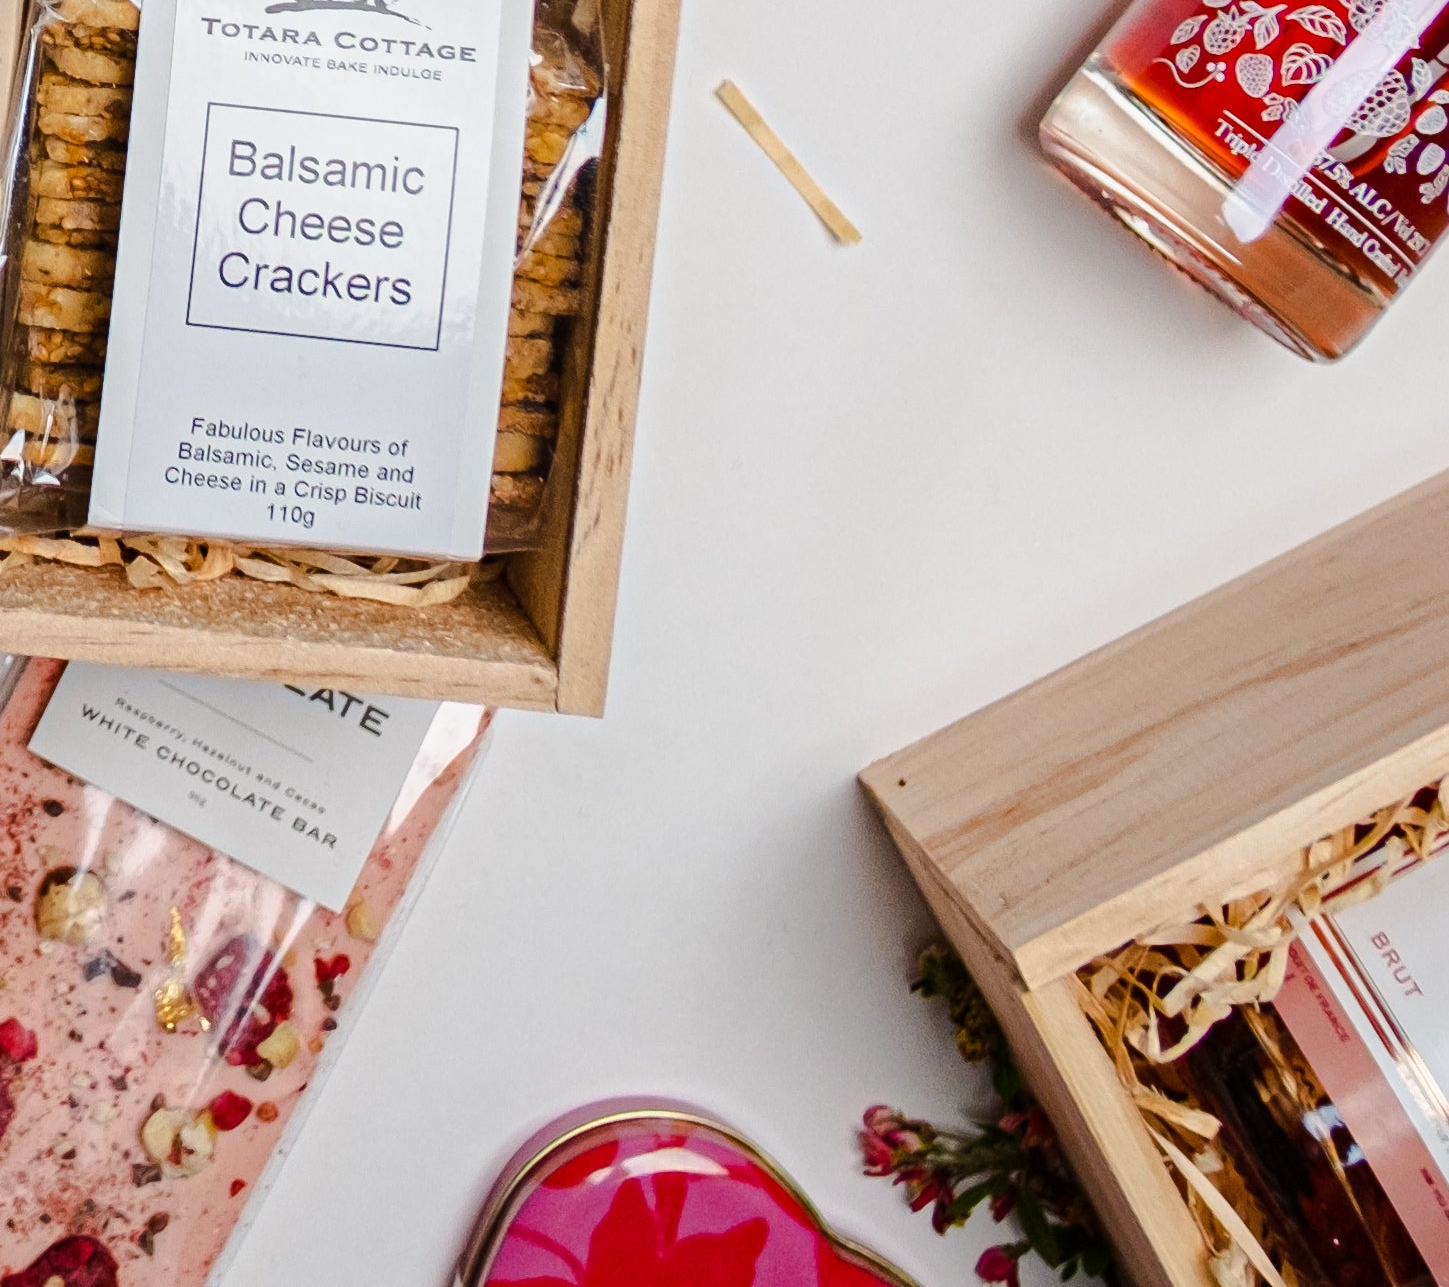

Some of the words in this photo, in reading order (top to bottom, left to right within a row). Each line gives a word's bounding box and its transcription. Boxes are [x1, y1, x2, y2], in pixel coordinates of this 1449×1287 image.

[201, 17, 322, 47] TOTARA
[334, 31, 477, 63] COTTAGE
[244, 50, 321, 69] INNOVATE
[327, 58, 368, 74] BAKE
[373, 63, 443, 81] INDULGE
[227, 139, 425, 195] Balsamic
[238, 197, 404, 249] Cheese
[218, 251, 413, 305] Crackers
[191, 417, 285, 445] Fabulous
[292, 428, 382, 456] Flavours
[388, 439, 409, 458] of
[178, 442, 278, 473] Balsamic,
[286, 454, 370, 480] Sesame
[377, 465, 415, 485] and
[164, 467, 243, 492] Cheese
[250, 475, 267, 495] in
[274, 482, 286, 497] a
[293, 479, 348, 505] Crisp
[354, 488, 424, 511] Biscuit
[266, 503, 316, 528] 110g
[81, 703, 151, 750] WHITE
[156, 744, 287, 822] CHOCOLATE
[291, 816, 339, 849] BAR
[1371, 931, 1424, 998] BRUT
